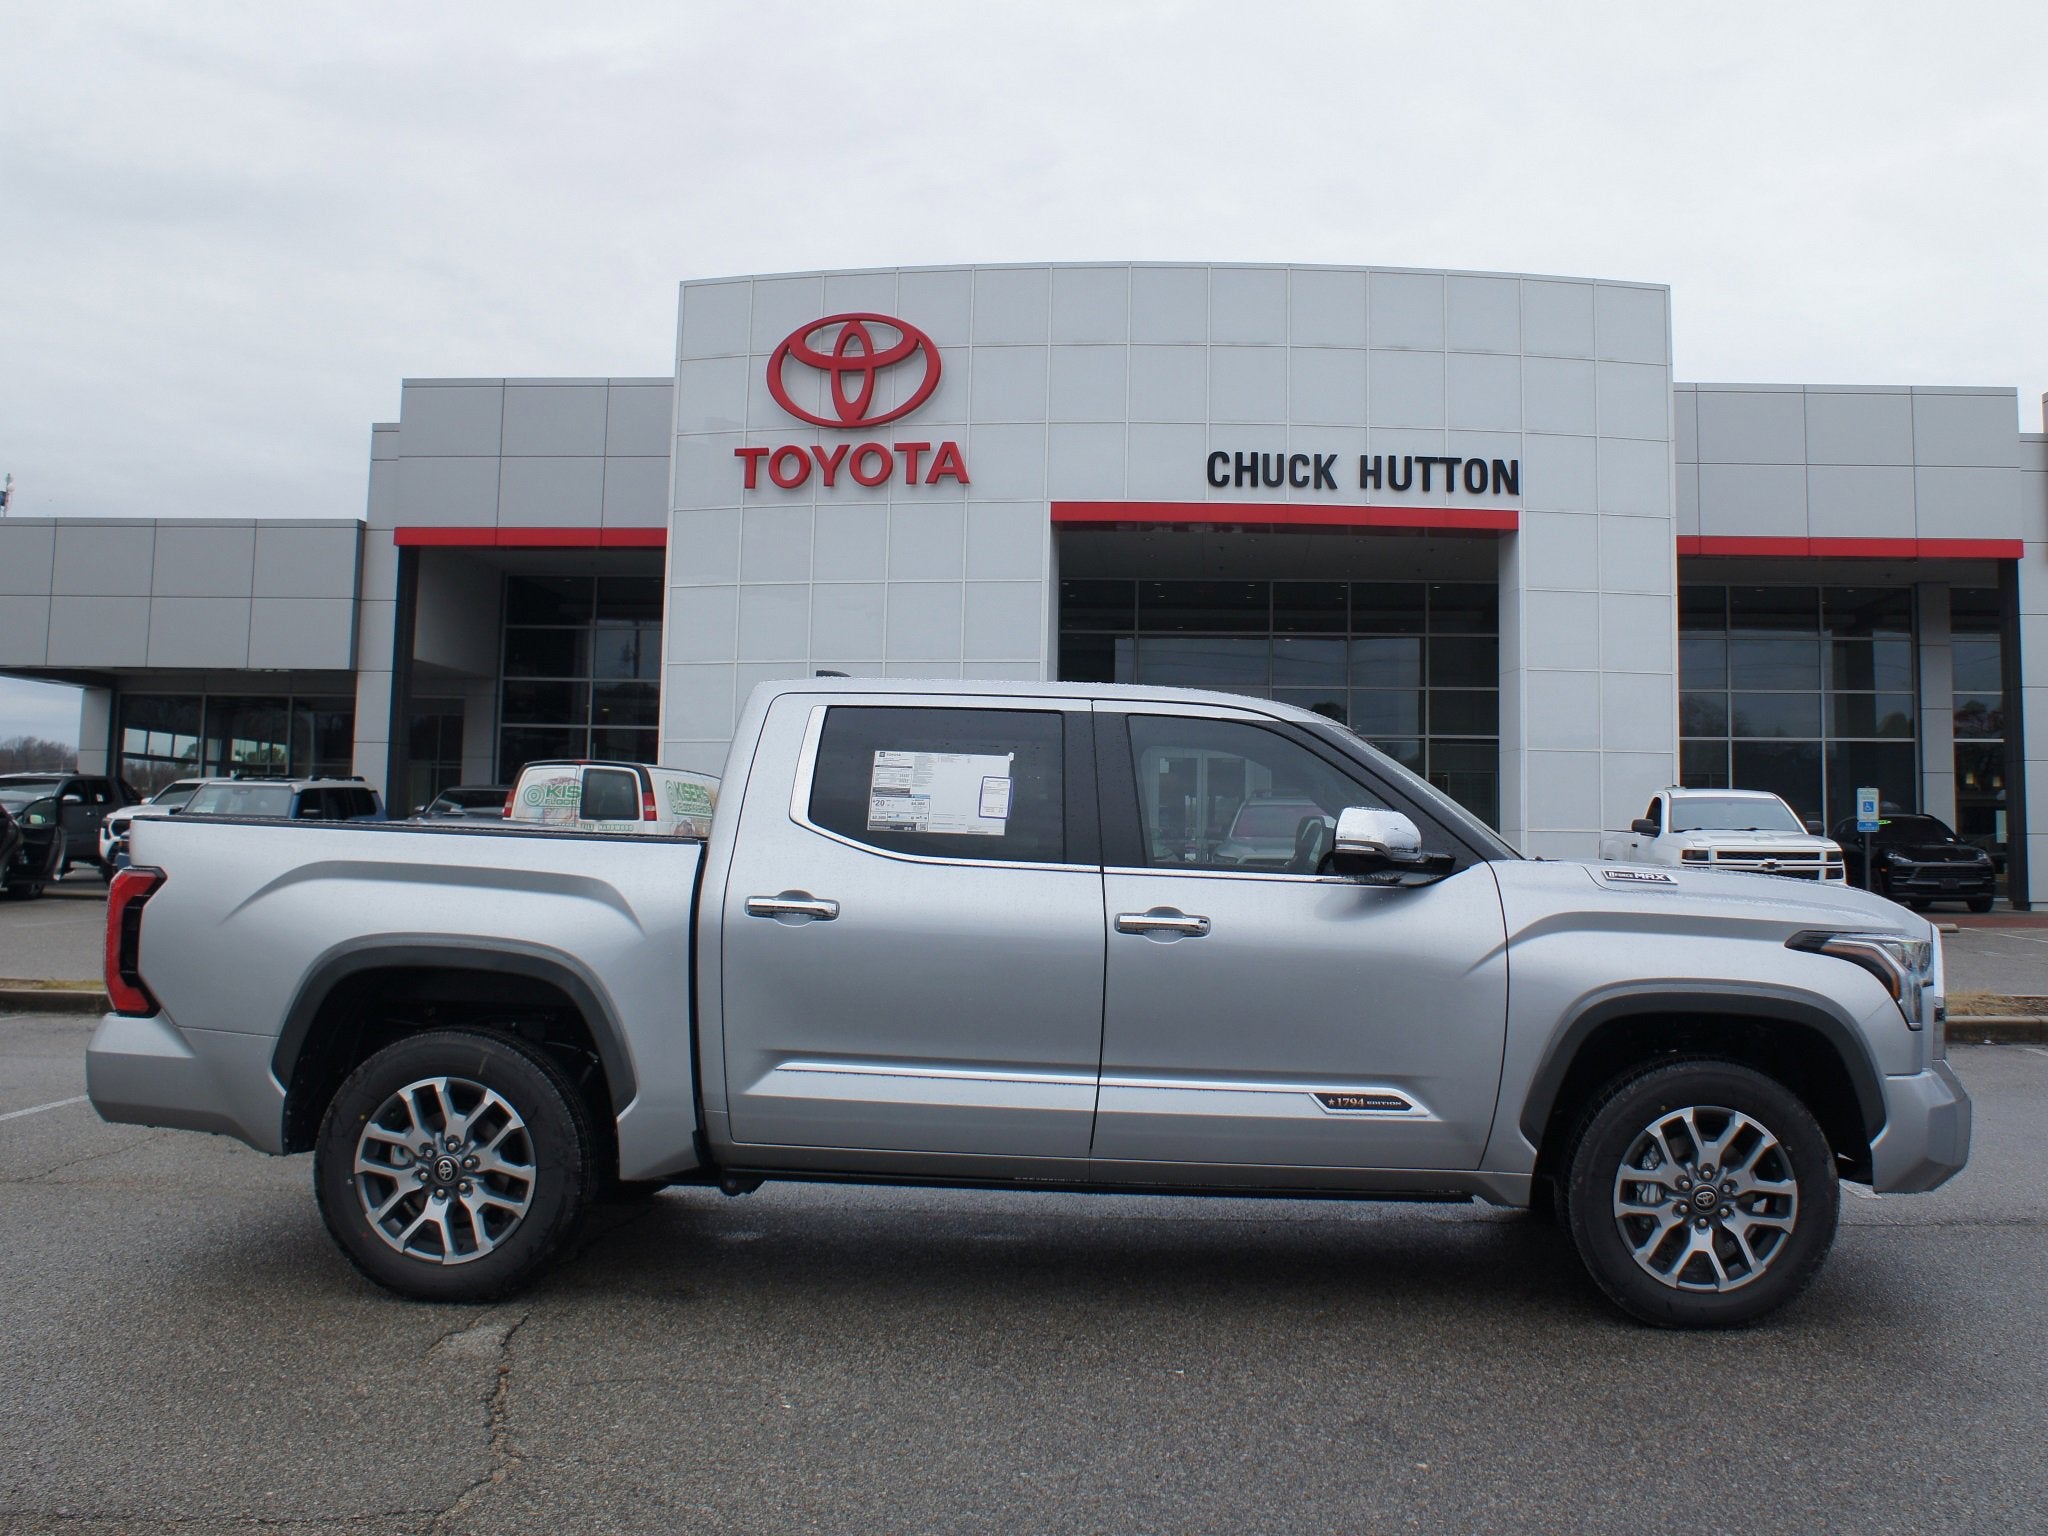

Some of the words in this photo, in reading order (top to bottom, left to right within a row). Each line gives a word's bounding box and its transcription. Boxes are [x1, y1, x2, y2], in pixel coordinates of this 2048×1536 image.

[734, 441, 970, 489] TOYOTA
[1207, 451, 1338, 490] CHUCK
[1359, 454, 1520, 496] HUTTON
[1634, 872, 1666, 881] MAX
[1337, 1097, 1364, 1107] 1794
